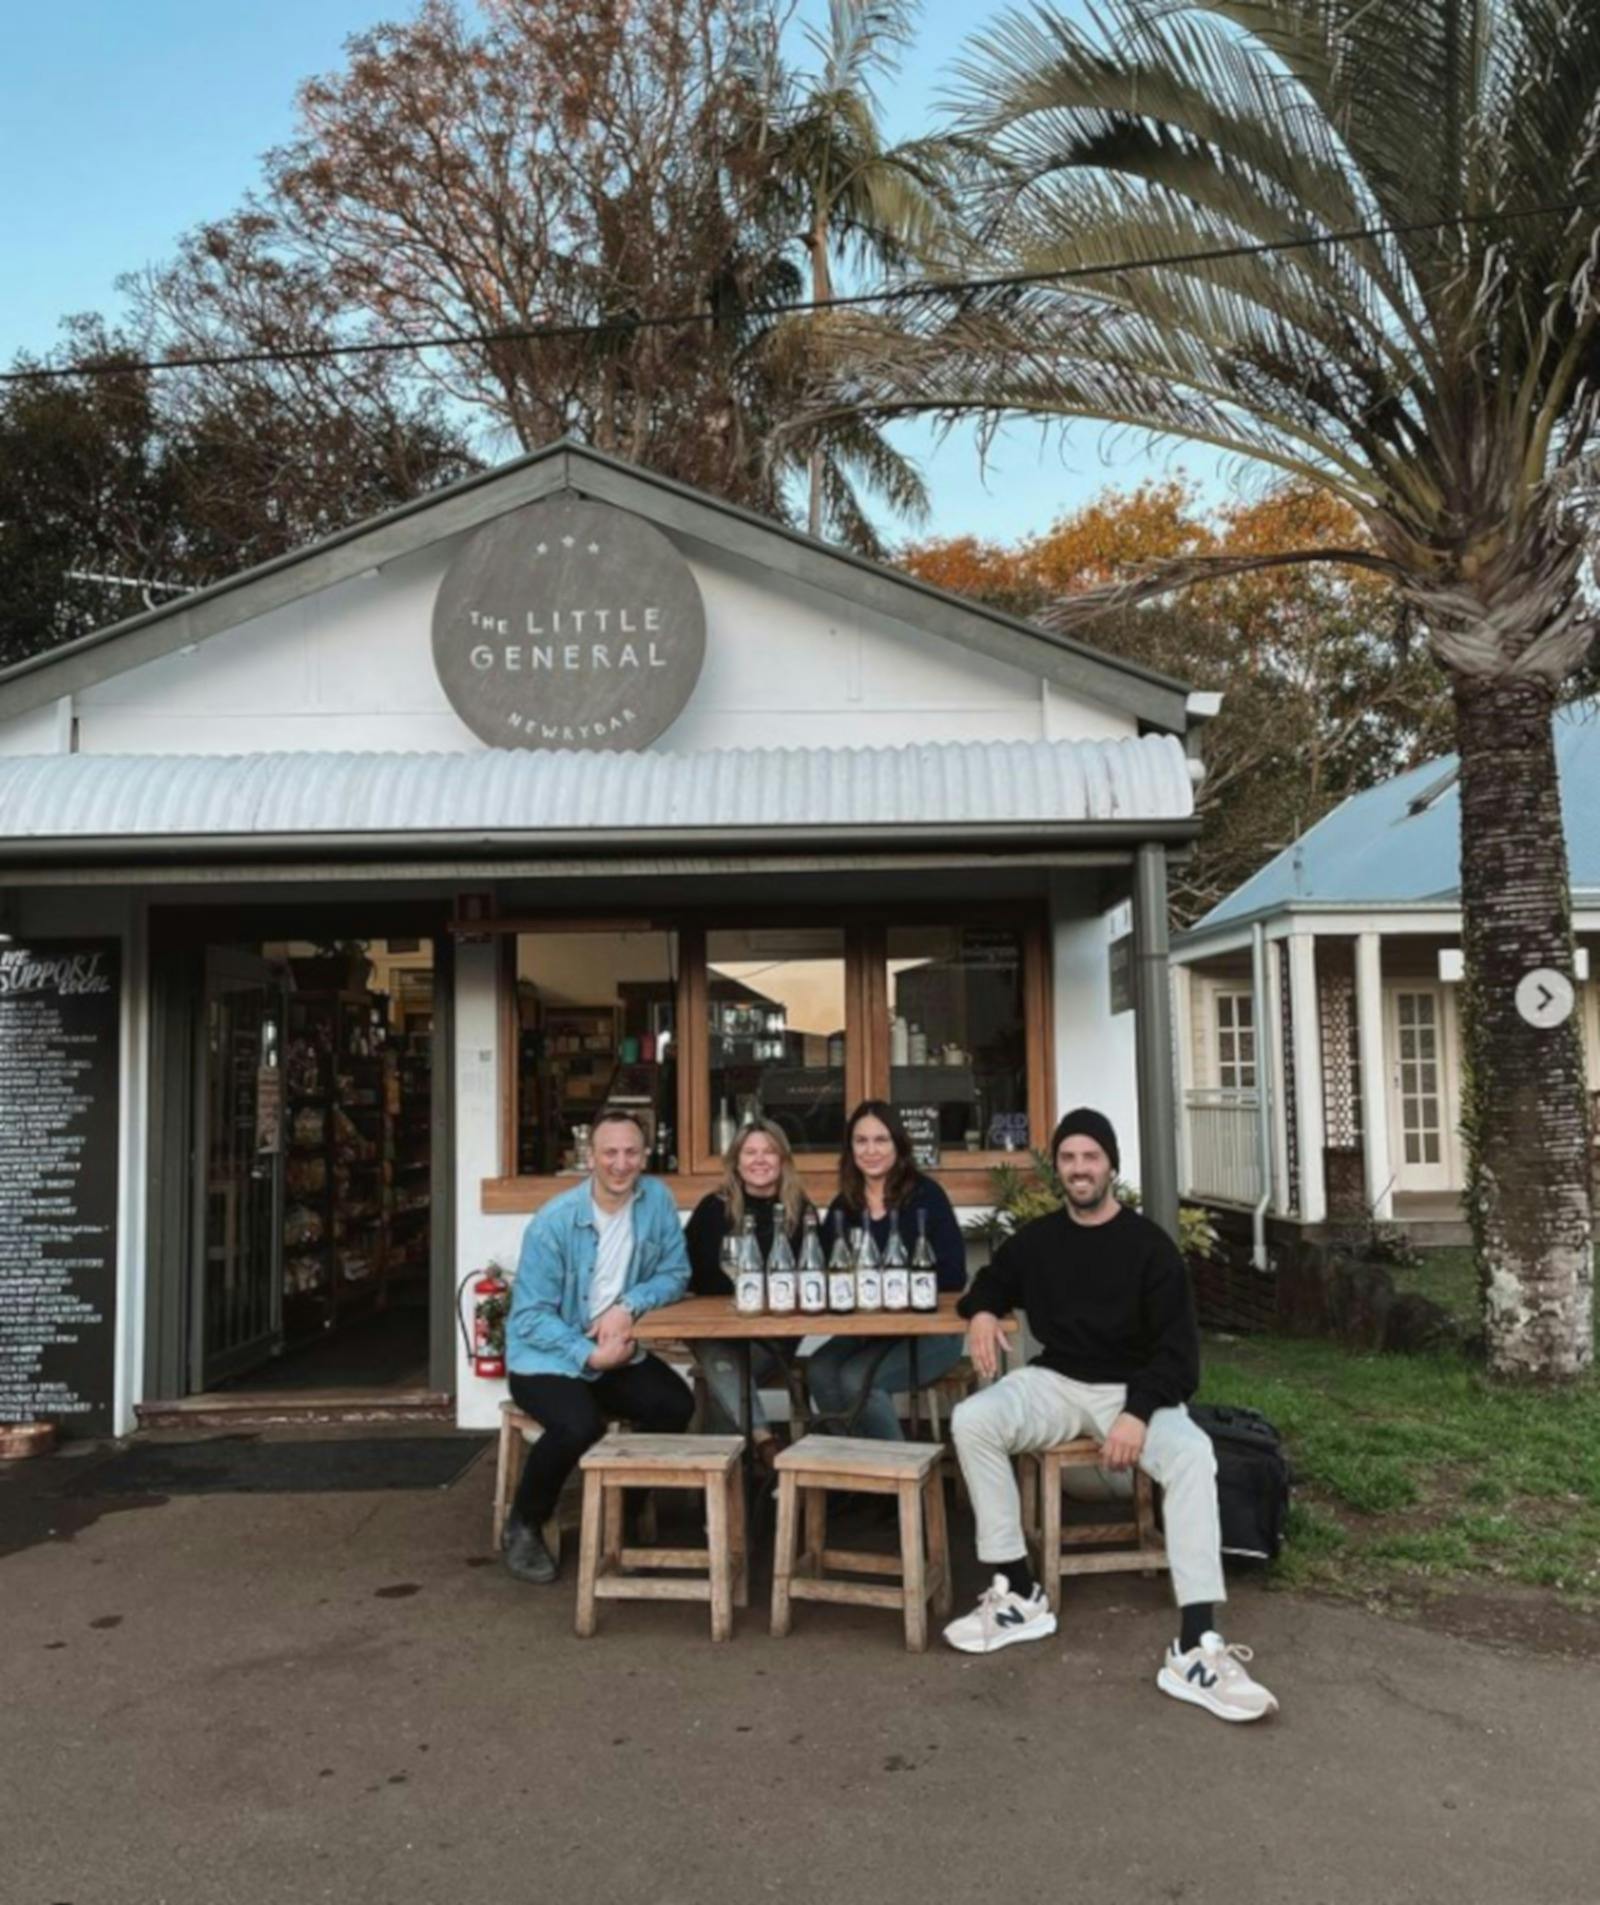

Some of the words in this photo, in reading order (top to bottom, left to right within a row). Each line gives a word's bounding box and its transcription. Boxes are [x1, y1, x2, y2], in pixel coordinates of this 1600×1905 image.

[469, 611, 508, 635] THE
[527, 608, 661, 634] LITTLE
[470, 642, 667, 670] GENERAL
[507, 708, 637, 740] NEWRYBAR
[995, 1606, 1025, 1628] N
[1187, 1661, 1218, 1688] N
